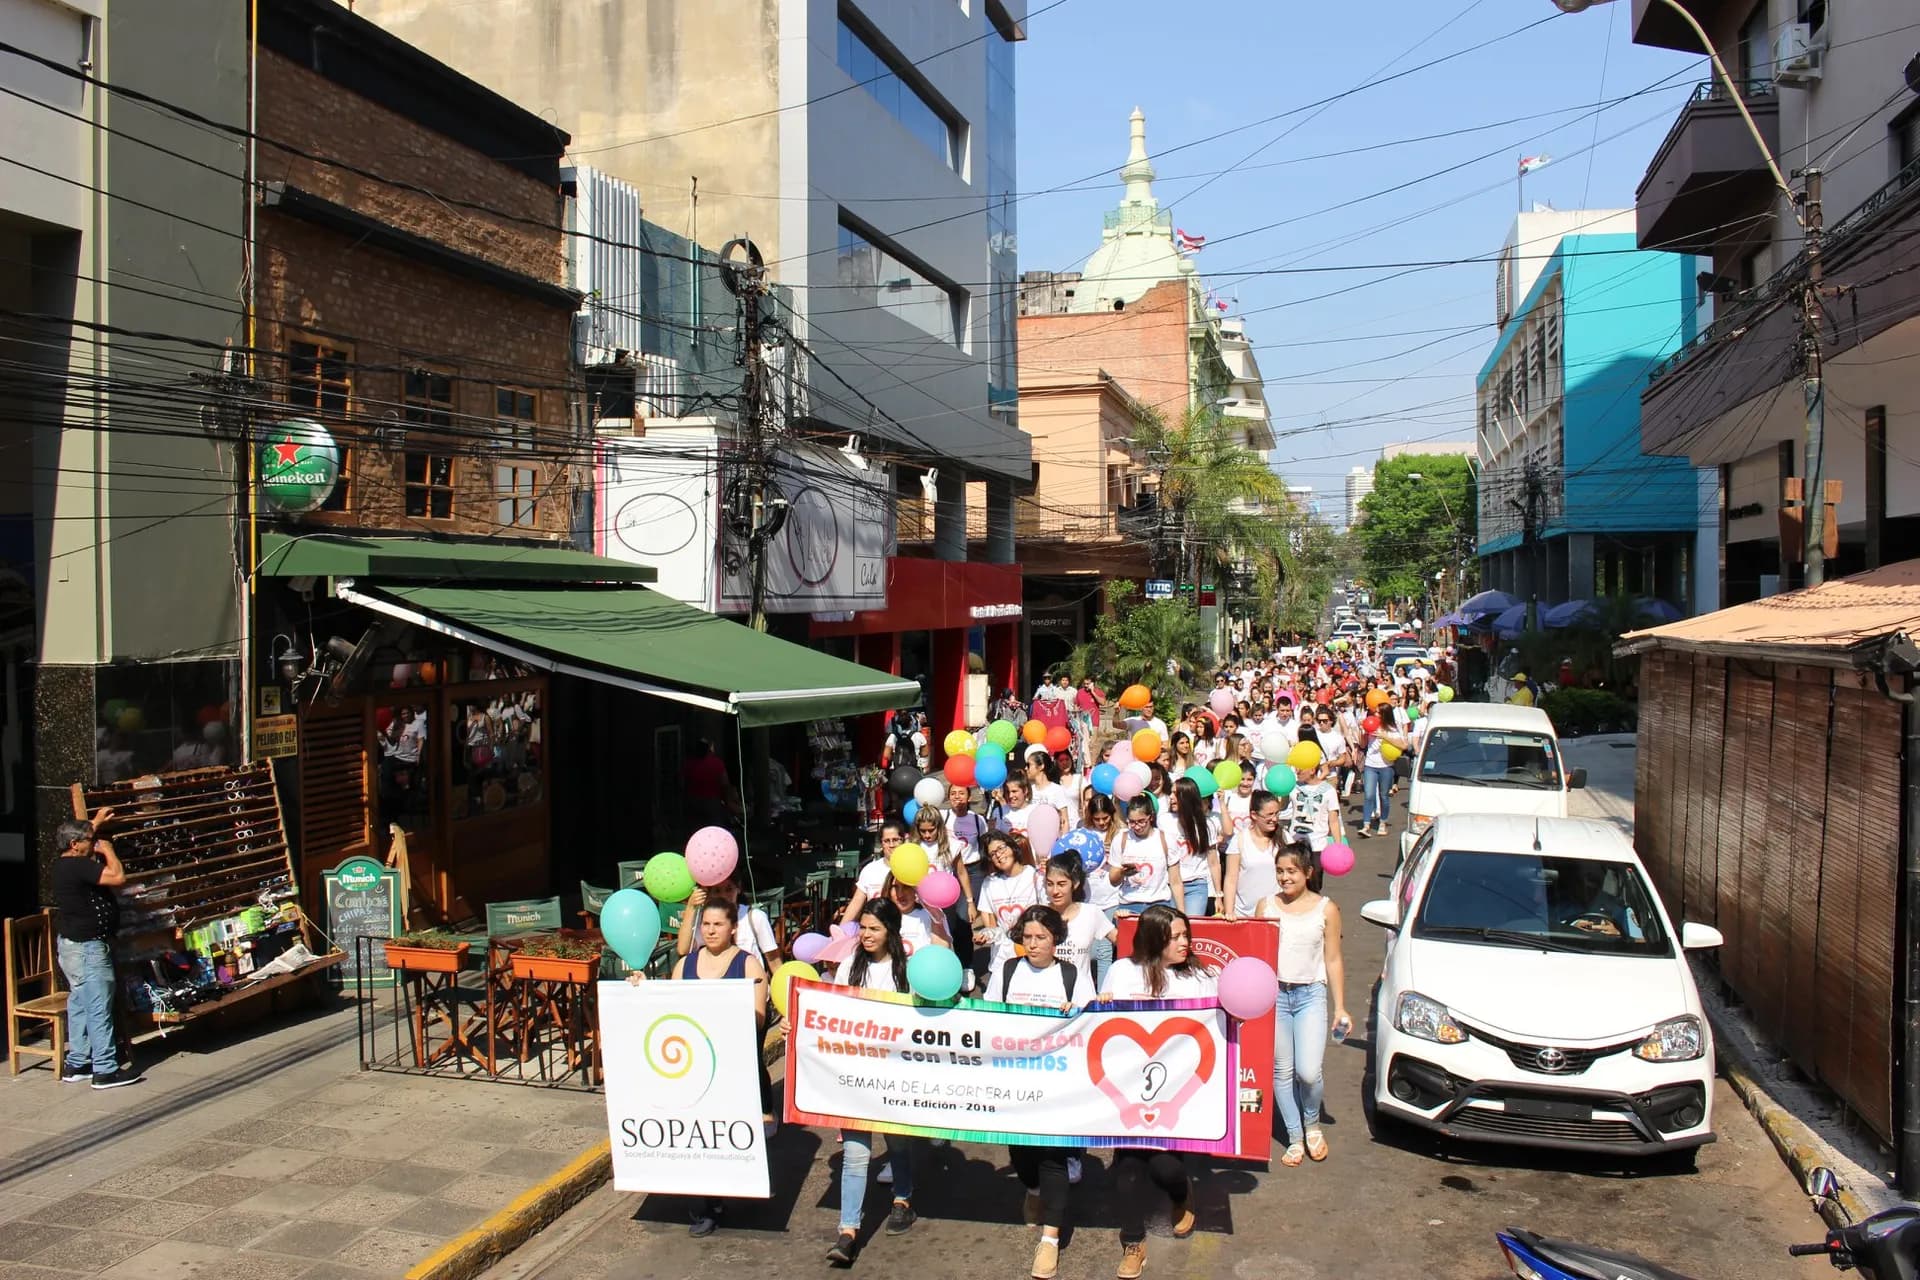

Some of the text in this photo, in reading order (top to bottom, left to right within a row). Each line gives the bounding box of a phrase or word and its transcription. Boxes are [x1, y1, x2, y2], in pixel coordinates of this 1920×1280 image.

[507, 911, 541, 924] Munich
[804, 1009, 1084, 1052] Escuchar con el corazón
[817, 1036, 1068, 1072] hablar con las manos
[838, 1074, 896, 1092] SEMANA
[901, 1080, 919, 1094] DE
[923, 1083, 940, 1095] LA
[1016, 1089, 1044, 1103] UAP
[882, 1096, 910, 1107] 1era.
[913, 1098, 957, 1110] Edición
[966, 1102, 996, 1113] 2018
[621, 1118, 755, 1151] SOPAFO
[624, 1150, 655, 1159] Sociedad
[656, 1151, 691, 1161] Paraguaya
[692, 1152, 701, 1160] de
